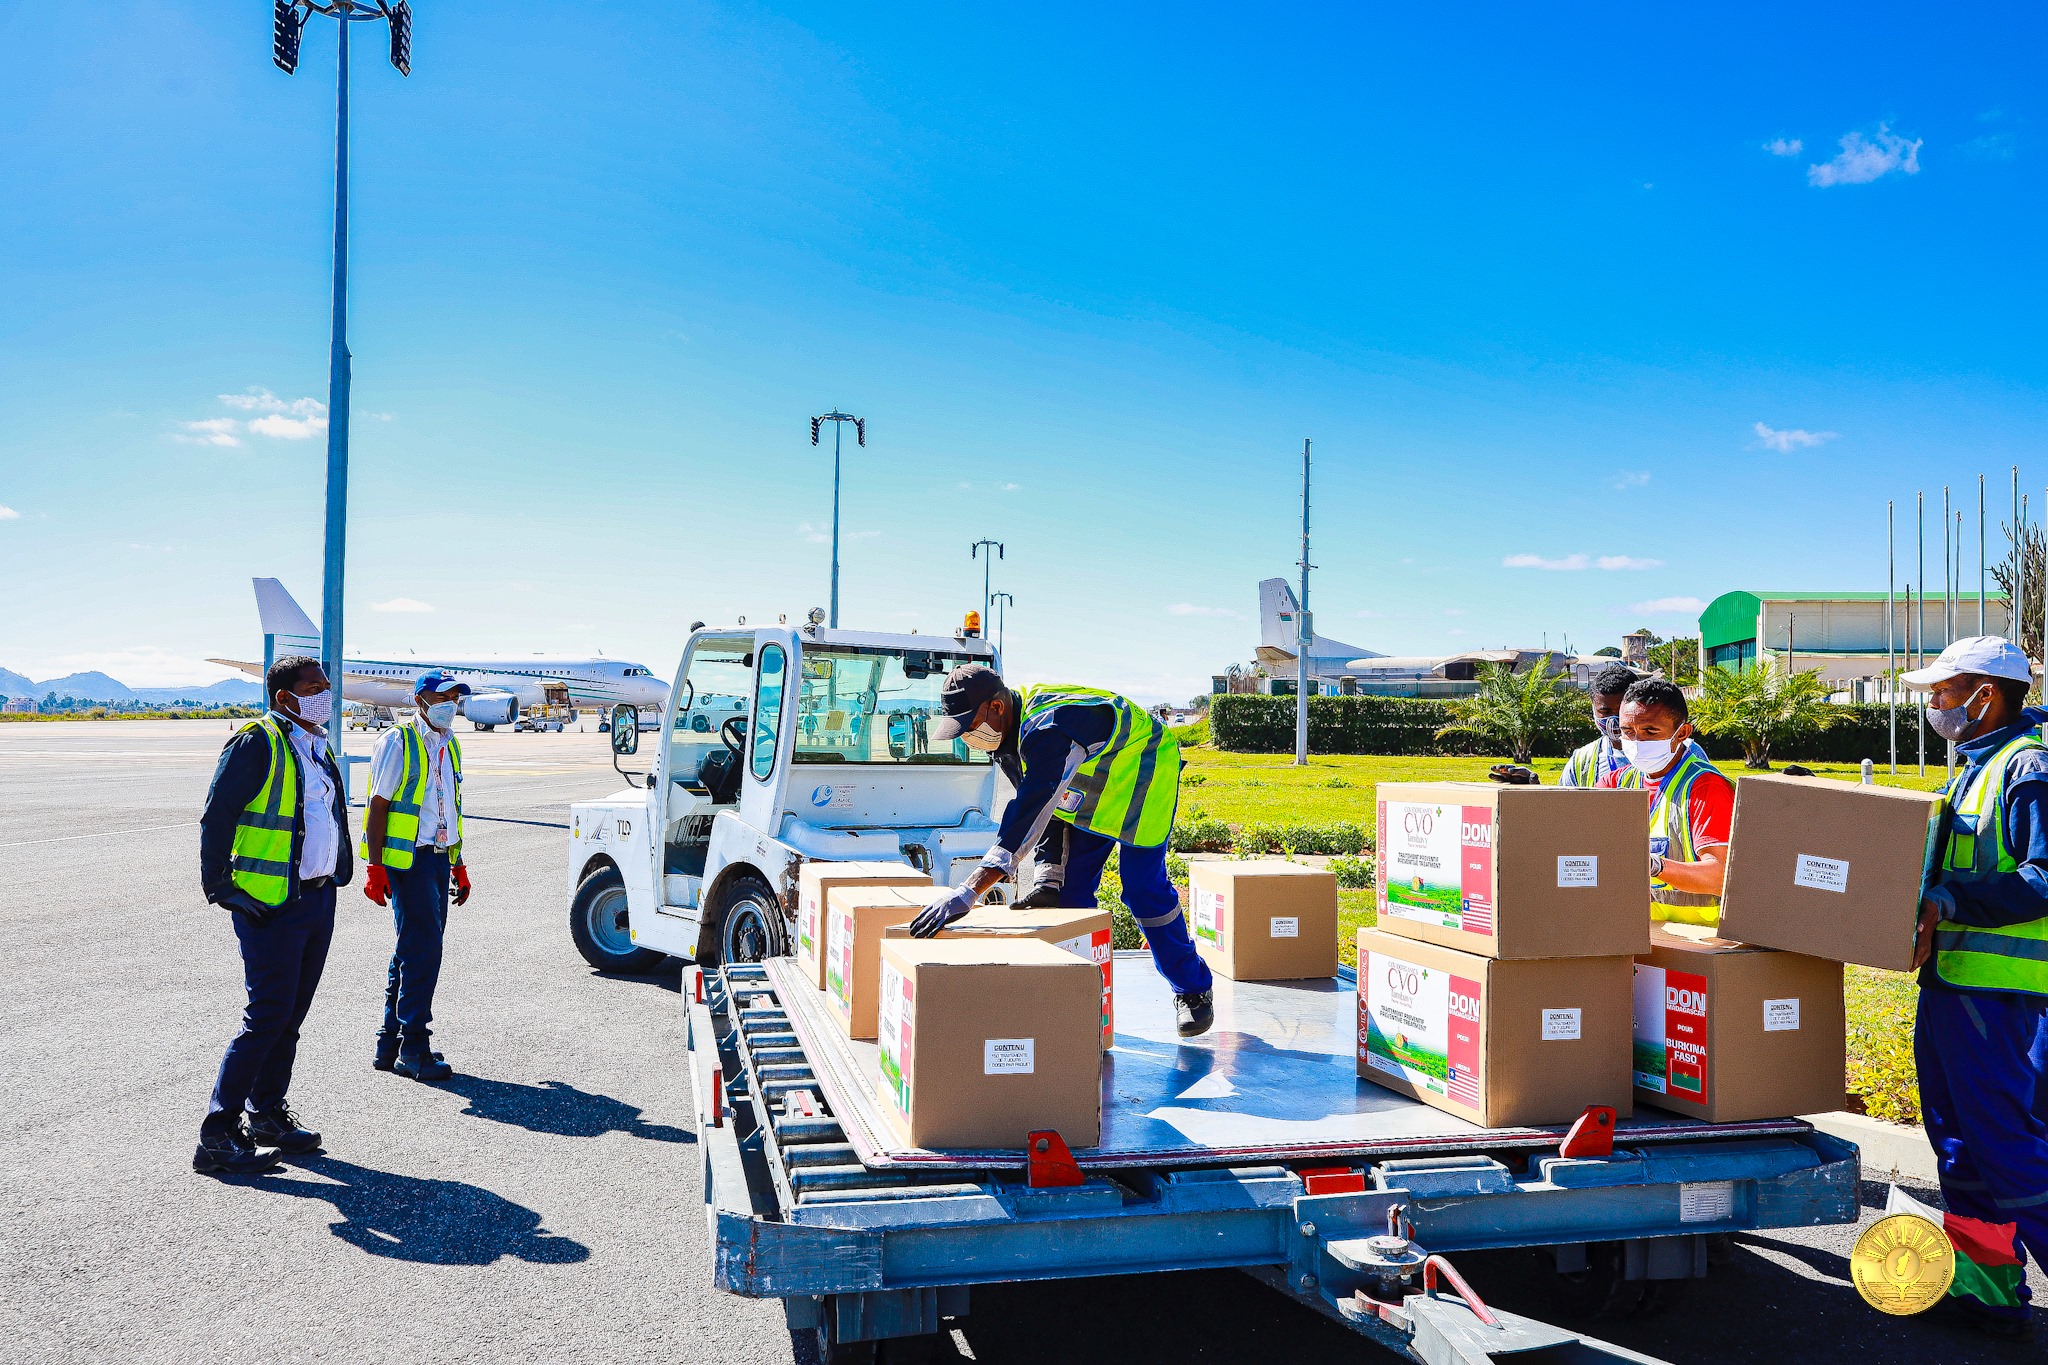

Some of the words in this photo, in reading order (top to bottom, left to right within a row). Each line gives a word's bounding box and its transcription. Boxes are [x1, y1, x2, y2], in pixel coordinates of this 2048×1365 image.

[1404, 812, 1433, 836] CVO
[1462, 822, 1491, 842] DON
[1806, 860, 1839, 870] CONTENU
[1092, 942, 1110, 961] DON
[1388, 968, 1418, 995] CVO
[1450, 991, 1480, 1016] DON
[1667, 986, 1706, 1011] DON
[1667, 1003, 1705, 1017] MADAGASCAR
[1677, 1024, 1693, 1033] POUR
[1666, 1038, 1706, 1056] BURKINA
[1674, 1050, 1697, 1064] FASO
